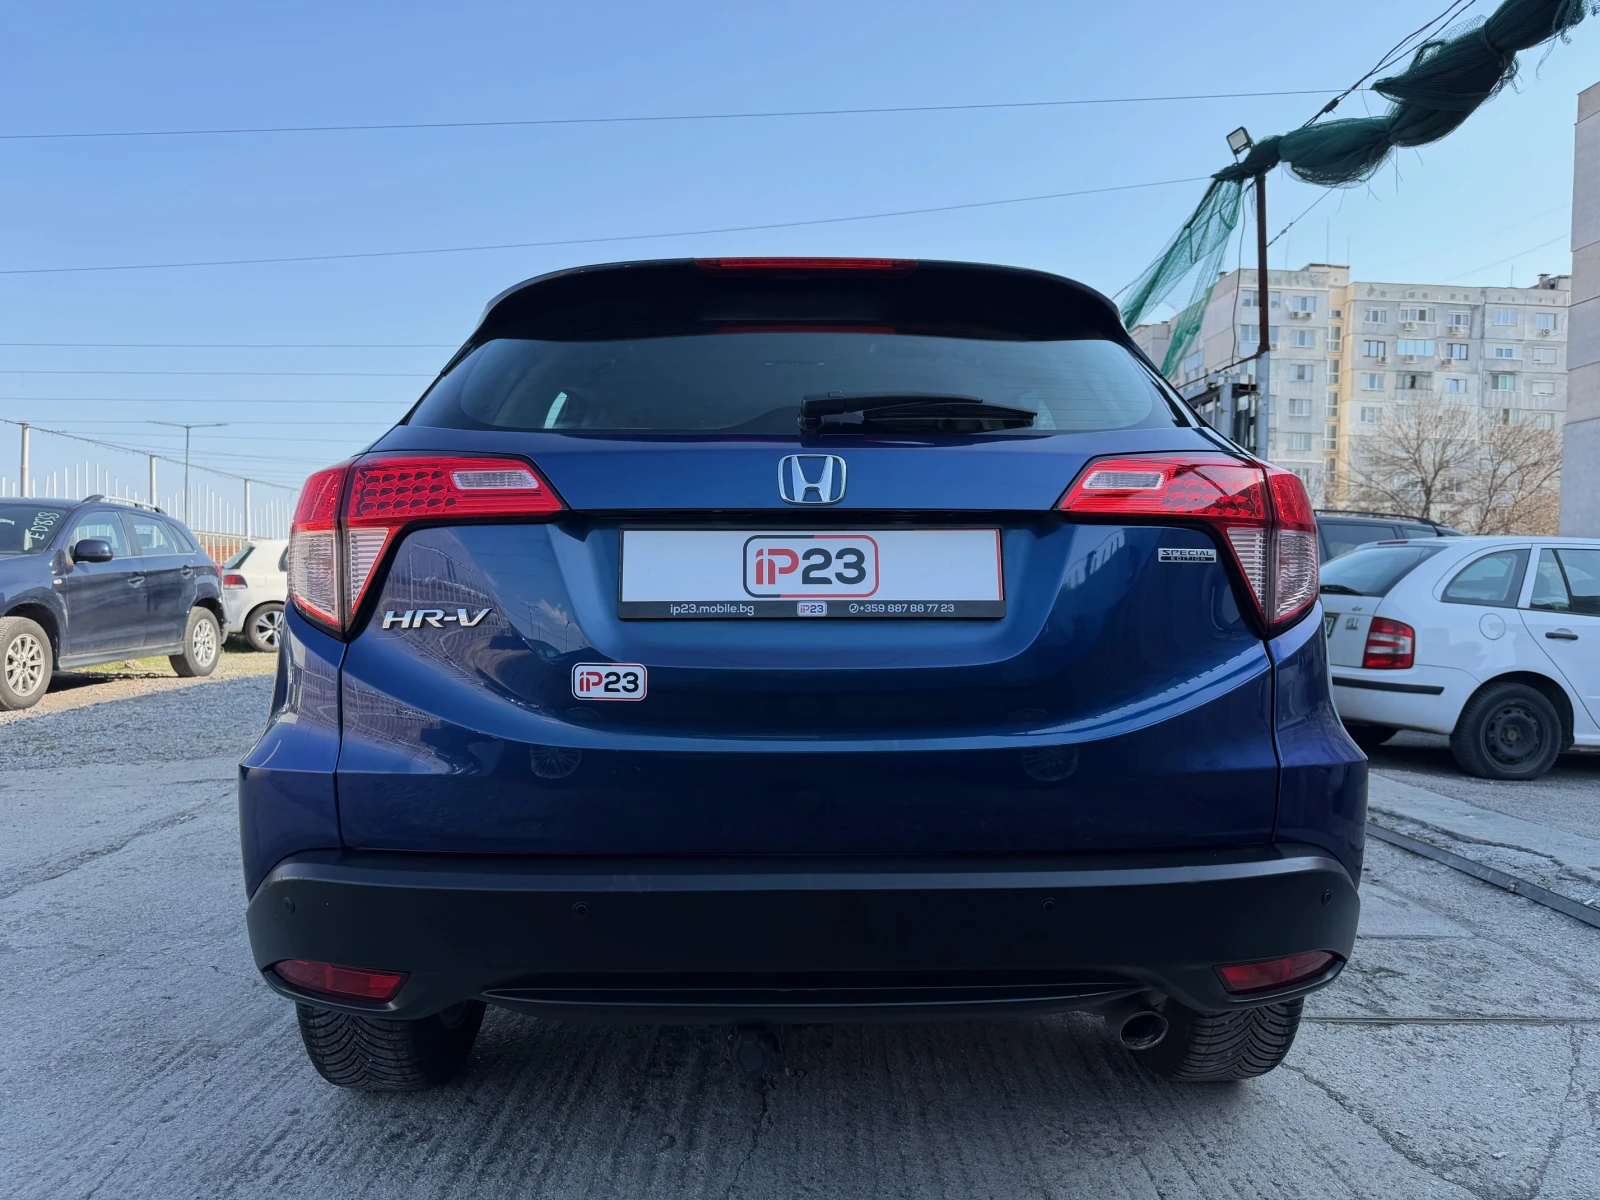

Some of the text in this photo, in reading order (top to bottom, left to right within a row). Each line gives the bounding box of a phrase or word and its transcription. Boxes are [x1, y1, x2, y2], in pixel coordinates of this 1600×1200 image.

[1161, 549, 1214, 557] SPECIAL
[670, 603, 755, 616] ip23.mobile.bg
[859, 603, 955, 613] +359 887 88 77 23
[382, 607, 493, 630] HR-V
